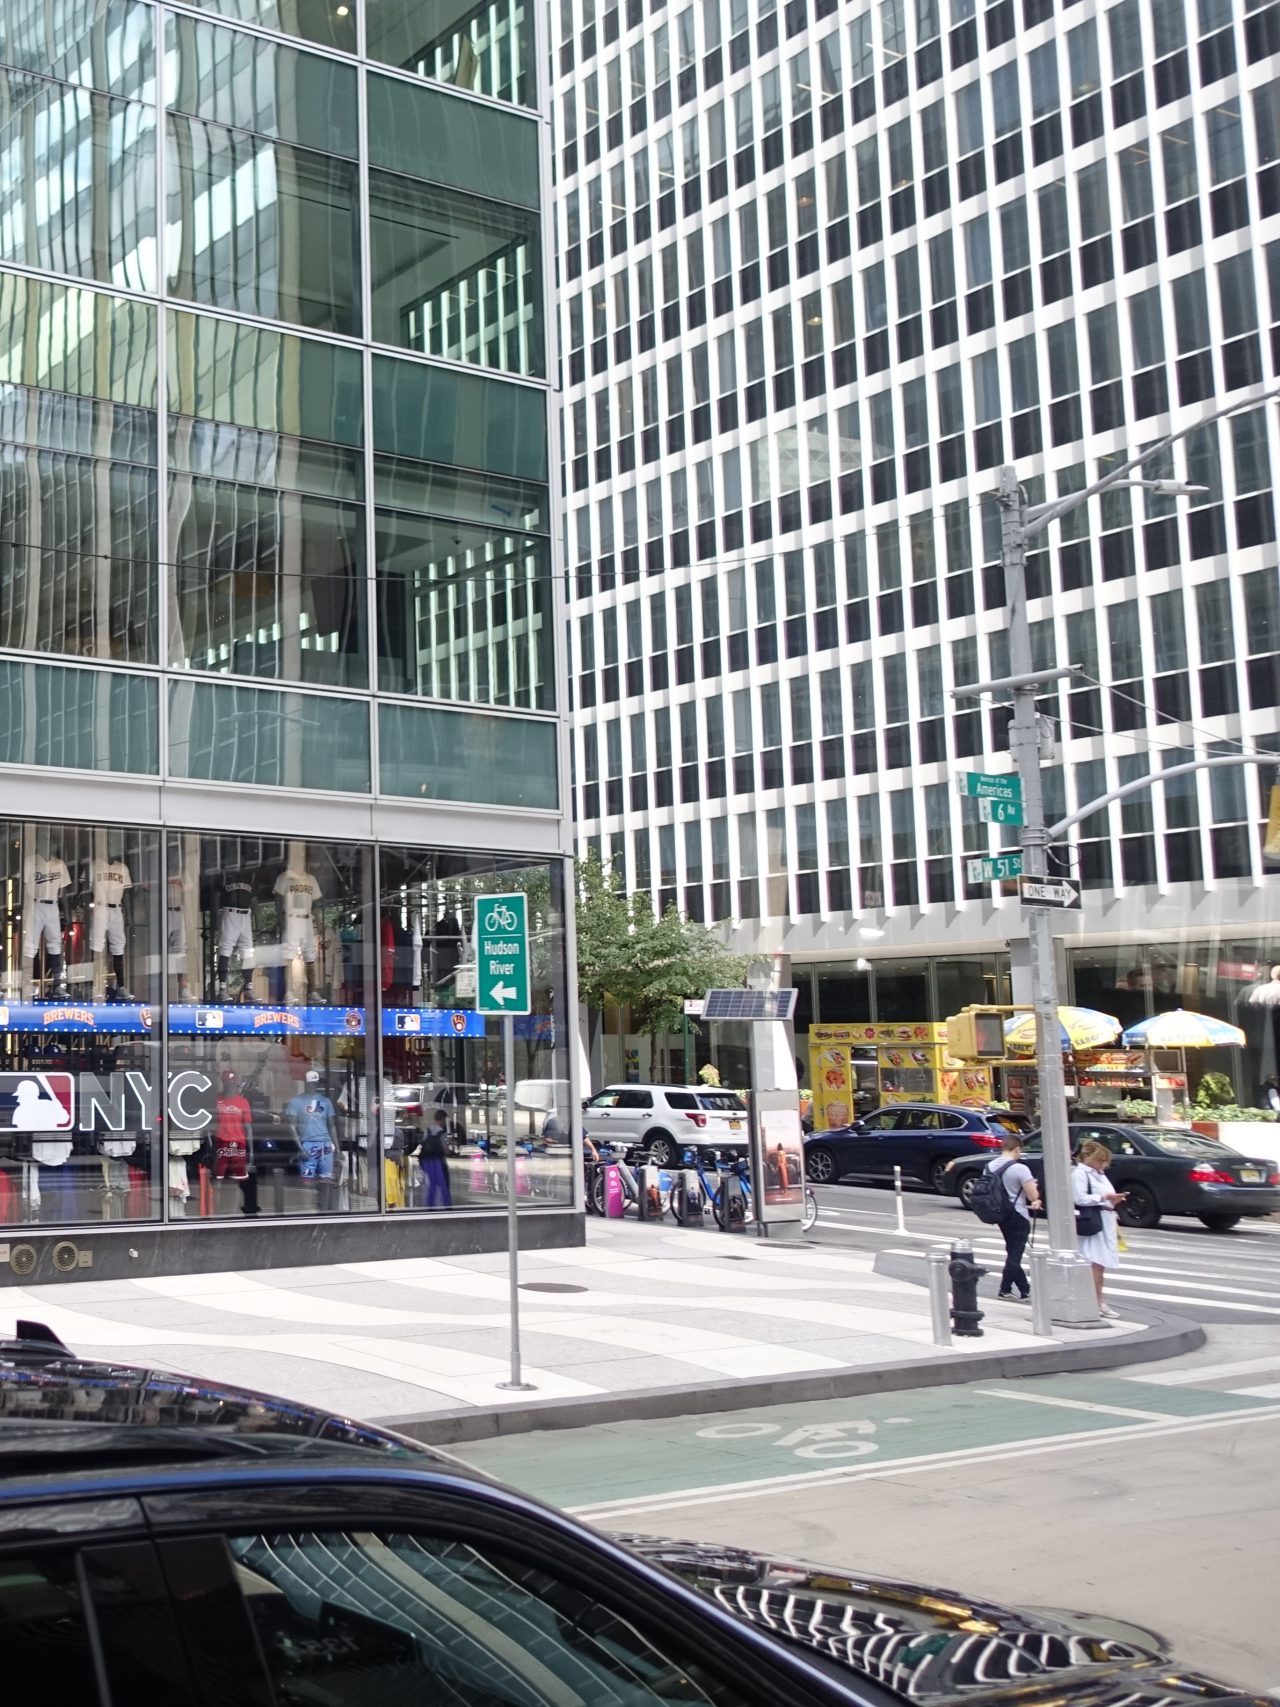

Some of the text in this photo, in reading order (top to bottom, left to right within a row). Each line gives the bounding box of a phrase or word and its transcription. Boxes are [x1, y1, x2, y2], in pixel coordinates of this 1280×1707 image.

[976, 782, 1013, 797] Americas
[997, 803, 1016, 820] 6 Av
[982, 857, 1022, 879] W 51 St
[1028, 885, 1072, 899] ONE WAY
[484, 940, 520, 956] Hudson
[489, 960, 515, 975] River
[43, 1007, 94, 1026] BREWERS
[253, 1011, 300, 1029] BREWERS
[79, 1070, 213, 1132] NYC
